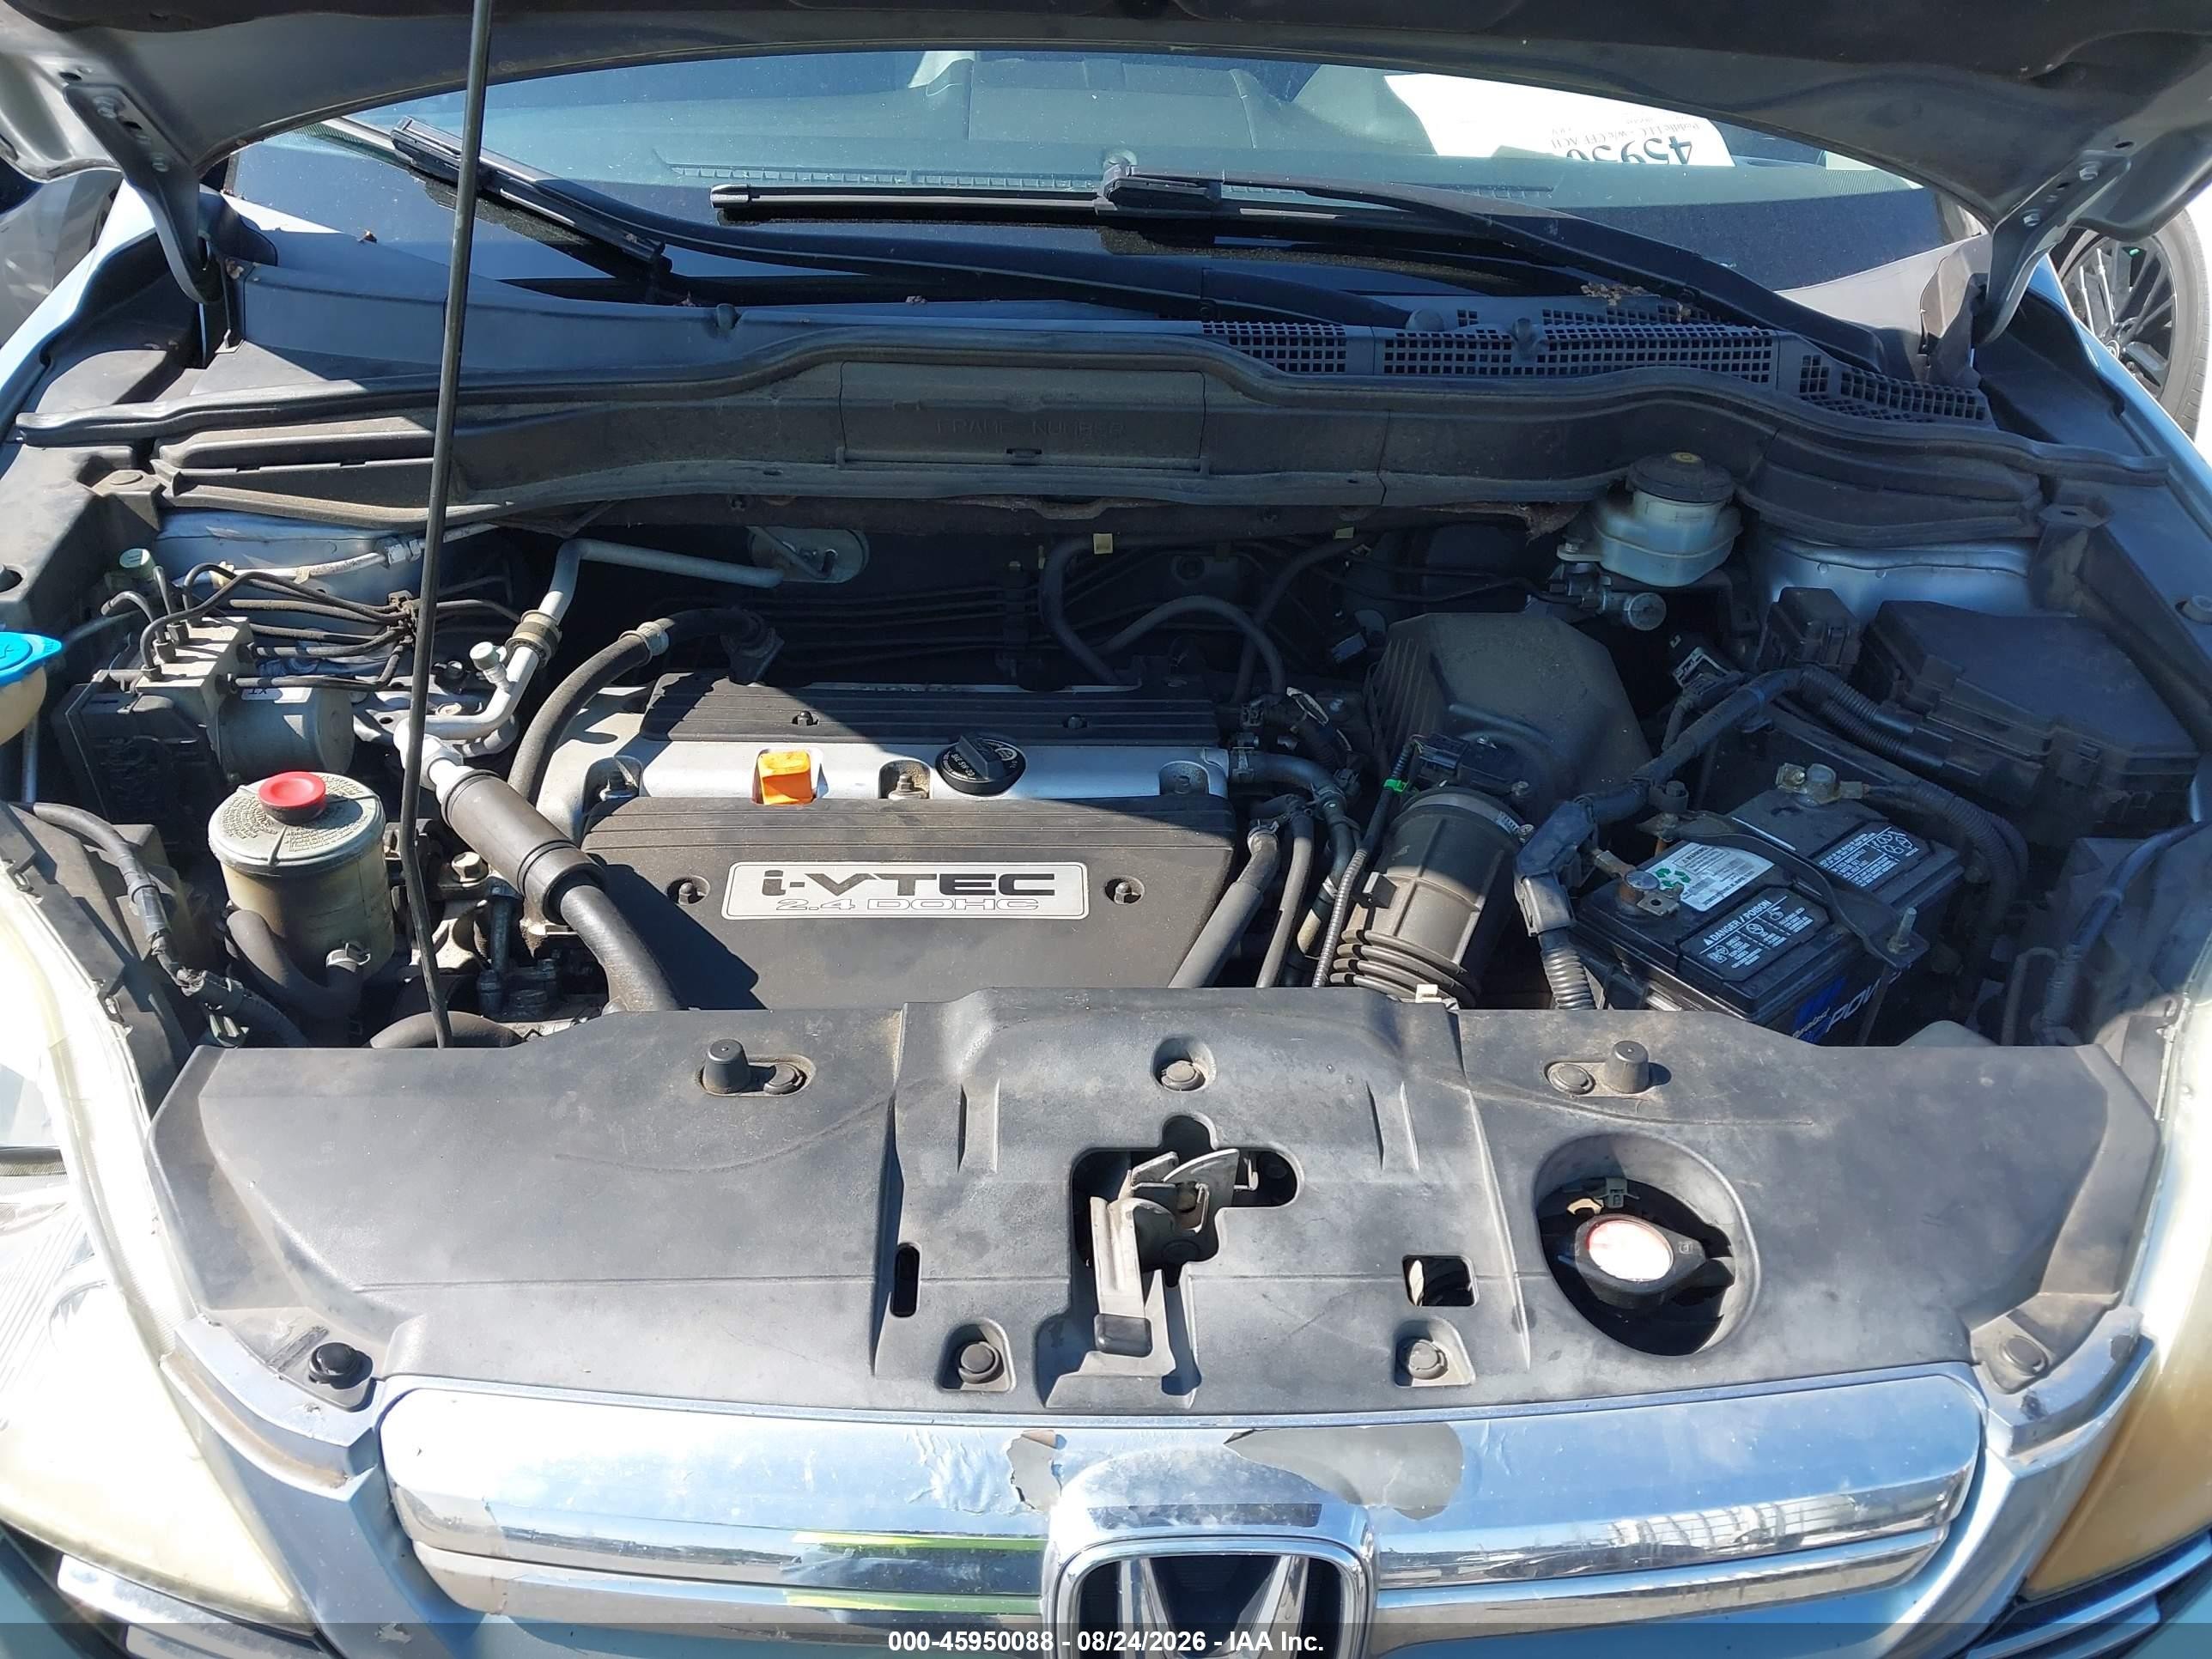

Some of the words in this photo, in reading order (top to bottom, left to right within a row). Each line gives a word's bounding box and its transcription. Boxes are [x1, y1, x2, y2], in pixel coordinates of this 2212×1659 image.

[762, 870, 1055, 896] i-VTEC
[775, 898, 855, 911] 2.4
[867, 897, 1040, 911] DOHC
[1710, 920, 1741, 941] DANGER
[1743, 900, 1772, 920] POISON
